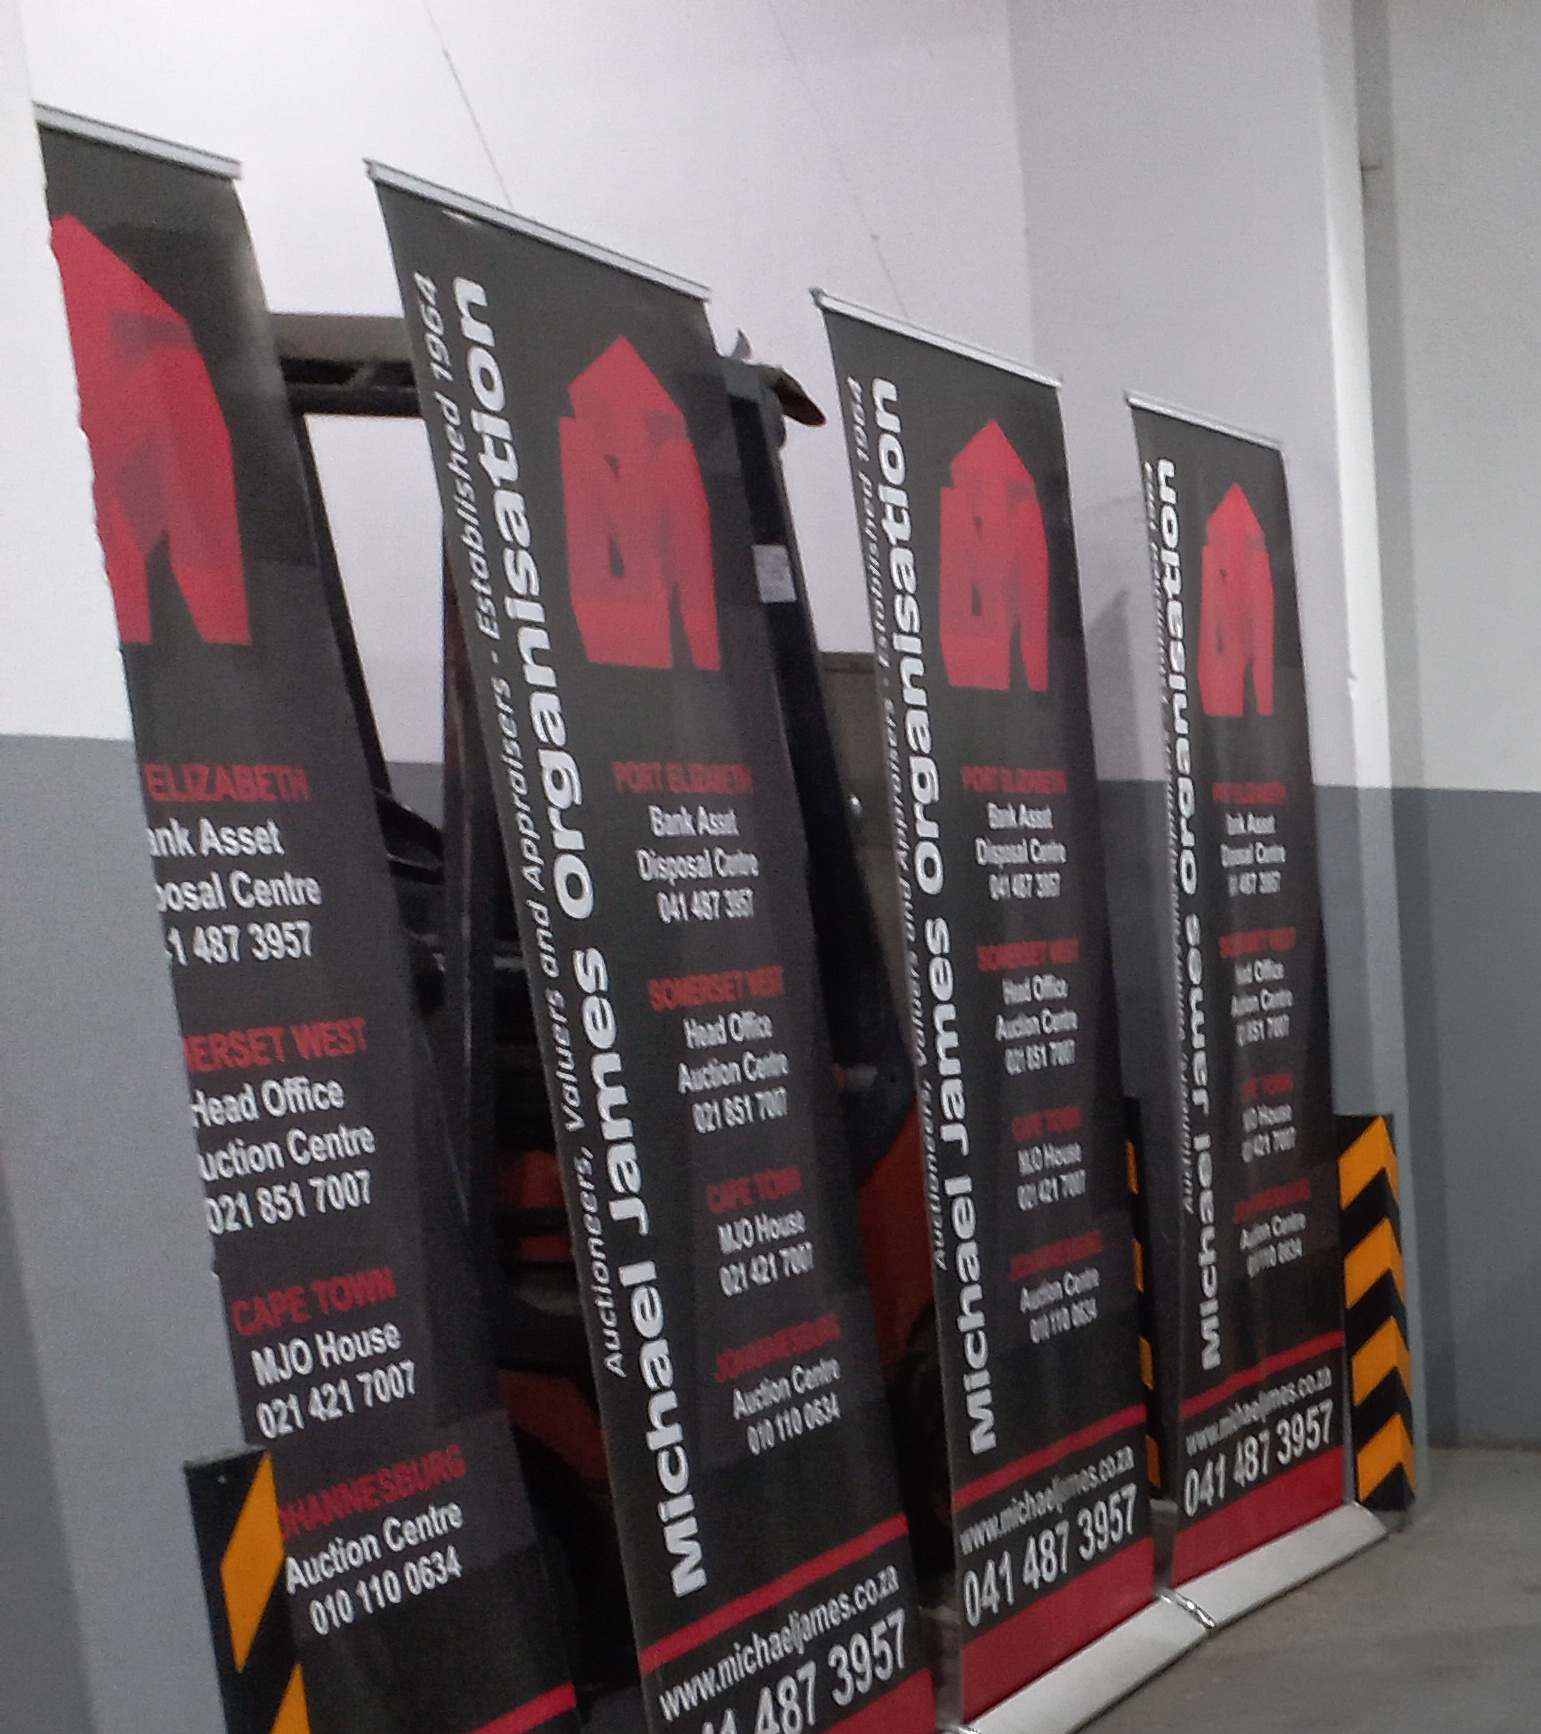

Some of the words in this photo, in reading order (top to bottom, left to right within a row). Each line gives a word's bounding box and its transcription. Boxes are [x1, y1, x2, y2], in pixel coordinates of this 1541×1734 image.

[412, 270, 455, 384] 1964
[434, 392, 500, 641] Established
[452, 276, 594, 919] Organisation
[872, 376, 944, 895] Organisation
[144, 762, 312, 803] ELIZABETH
[490, 676, 546, 893] Appraisers
[147, 818, 196, 856] ank
[199, 817, 285, 856] Asset
[229, 869, 323, 909] Centre
[526, 900, 559, 978] and
[192, 924, 240, 964] 487
[247, 920, 313, 961] 3957
[183, 1026, 285, 1072] ERSET
[289, 1016, 368, 1060] WEST
[544, 986, 586, 1132] Valuers
[924, 917, 969, 1156] James
[191, 1083, 260, 1128] Head
[260, 1075, 345, 1118] Office
[572, 946, 650, 1237] James
[198, 1137, 284, 1182] uction
[286, 1122, 376, 1166] Centre
[204, 1191, 254, 1235] 021
[255, 1181, 306, 1225] 851
[308, 1169, 372, 1214] 7007
[231, 1285, 311, 1336] CAPE
[311, 1265, 397, 1315] TOWN
[573, 1147, 627, 1377] Auctioneers,
[250, 1337, 314, 1387] MJO
[314, 1322, 401, 1368] House
[944, 1174, 997, 1455] Michael
[255, 1393, 305, 1440] 021
[307, 1378, 355, 1422] 421
[355, 1359, 416, 1407] 7007
[619, 1260, 707, 1598] Michael
[1184, 1452, 1226, 1517] 041
[1276, 1399, 1333, 1465] 3957
[285, 1536, 382, 1595] Auction
[382, 1502, 465, 1553] Centre
[308, 1589, 355, 1636] 010
[355, 1569, 401, 1614] 110
[403, 1545, 463, 1596] 0634
[963, 1550, 1014, 1627] 041
[1023, 1520, 1070, 1590] 487
[1076, 1482, 1137, 1560] 3957
[659, 1564, 900, 1722] www.michaeljames.co.za
[828, 1607, 906, 1707] 3957
